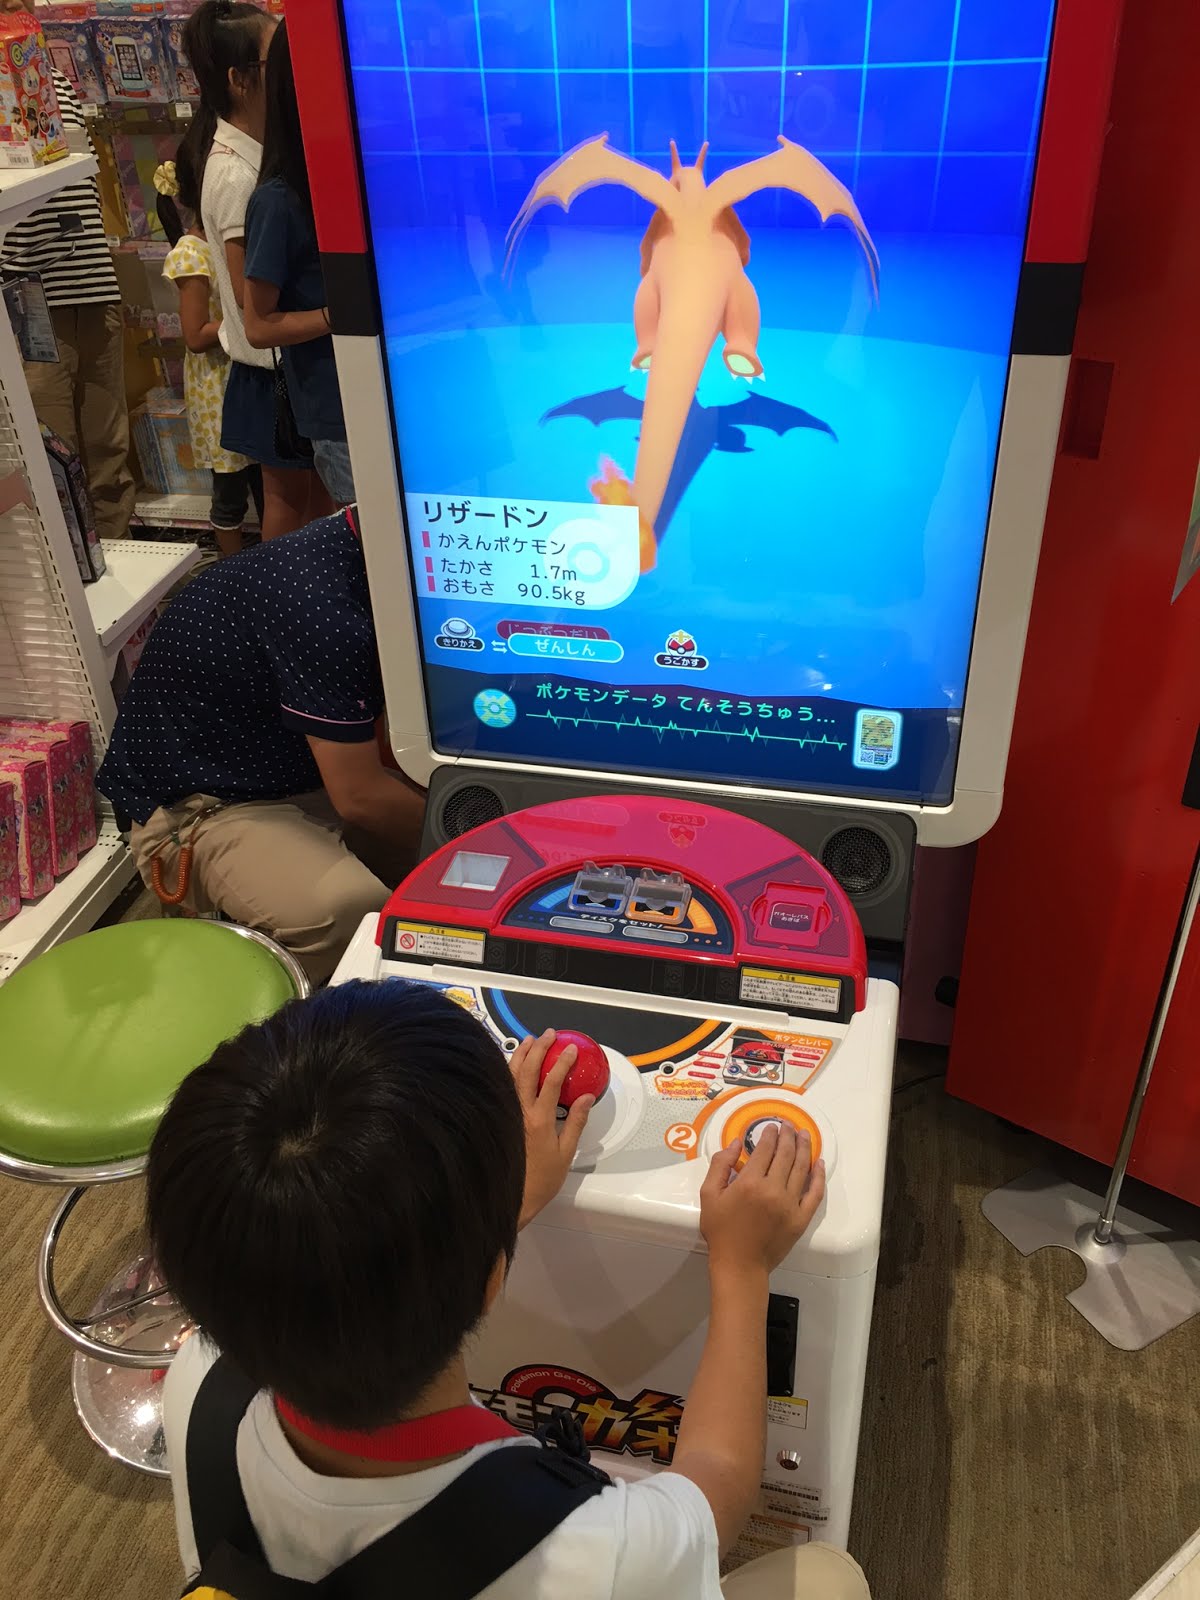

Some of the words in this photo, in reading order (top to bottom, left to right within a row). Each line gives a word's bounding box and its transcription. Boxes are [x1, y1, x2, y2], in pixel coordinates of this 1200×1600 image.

[423, 500, 548, 529] リザードン
[437, 532, 566, 556] かえんポケモン
[440, 557, 494, 577] たかさ
[529, 563, 578, 581] 1.7m
[442, 577, 496, 597] おもさ
[517, 583, 586, 606] 90.5kg
[442, 637, 478, 649] きりかえ
[534, 638, 596, 657] ぜんしん
[663, 655, 700, 667] うごかす
[535, 682, 668, 709] ポケモンデータ
[774, 1034, 829, 1047] ボタンとレバー
[671, 1126, 692, 1149] 2
[510, 1370, 550, 1394] Pokémon
